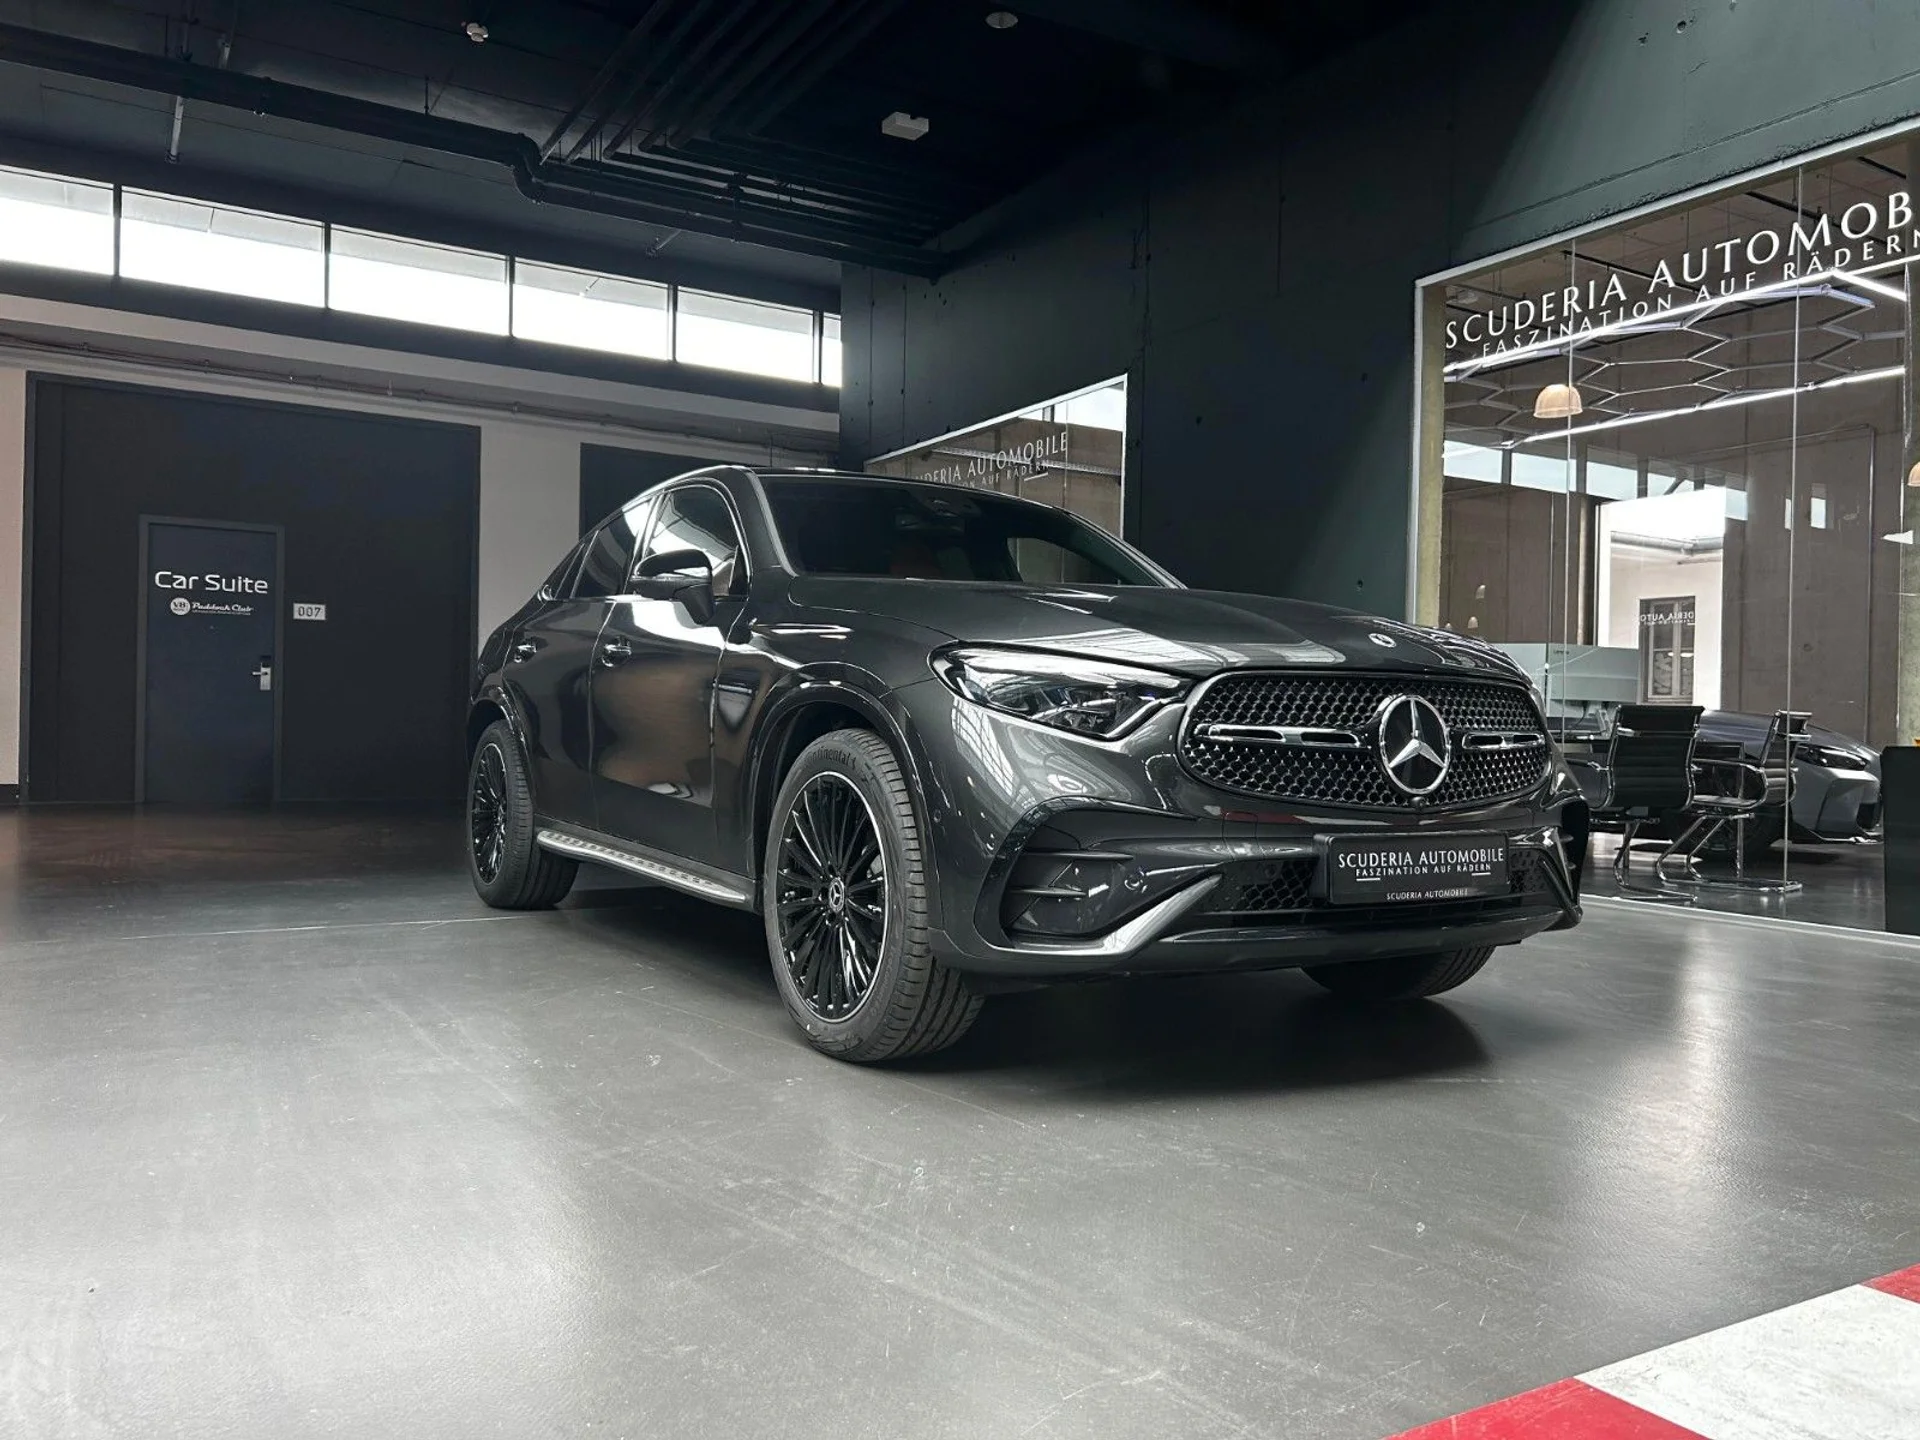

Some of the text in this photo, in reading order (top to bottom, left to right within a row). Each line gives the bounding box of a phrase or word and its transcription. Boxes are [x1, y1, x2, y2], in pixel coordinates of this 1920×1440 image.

[1446, 191, 1912, 349] SCUDERIA AUTOMOB
[1483, 293, 1672, 359] FASZINATION
[1696, 271, 1756, 302] AUF
[967, 431, 1067, 478] AUTOMOBILE
[982, 474, 1000, 486] AUF
[154, 571, 268, 594] Car Suite
[297, 606, 321, 618] 007
[804, 746, 851, 766] ntinental
[1338, 848, 1504, 868] SCUDERIA AUTOMOBILE
[1356, 863, 1492, 877] FASZINATION AUF RÄDERN
[1386, 888, 1468, 900] SCUDERIA AUTOMOBILE
